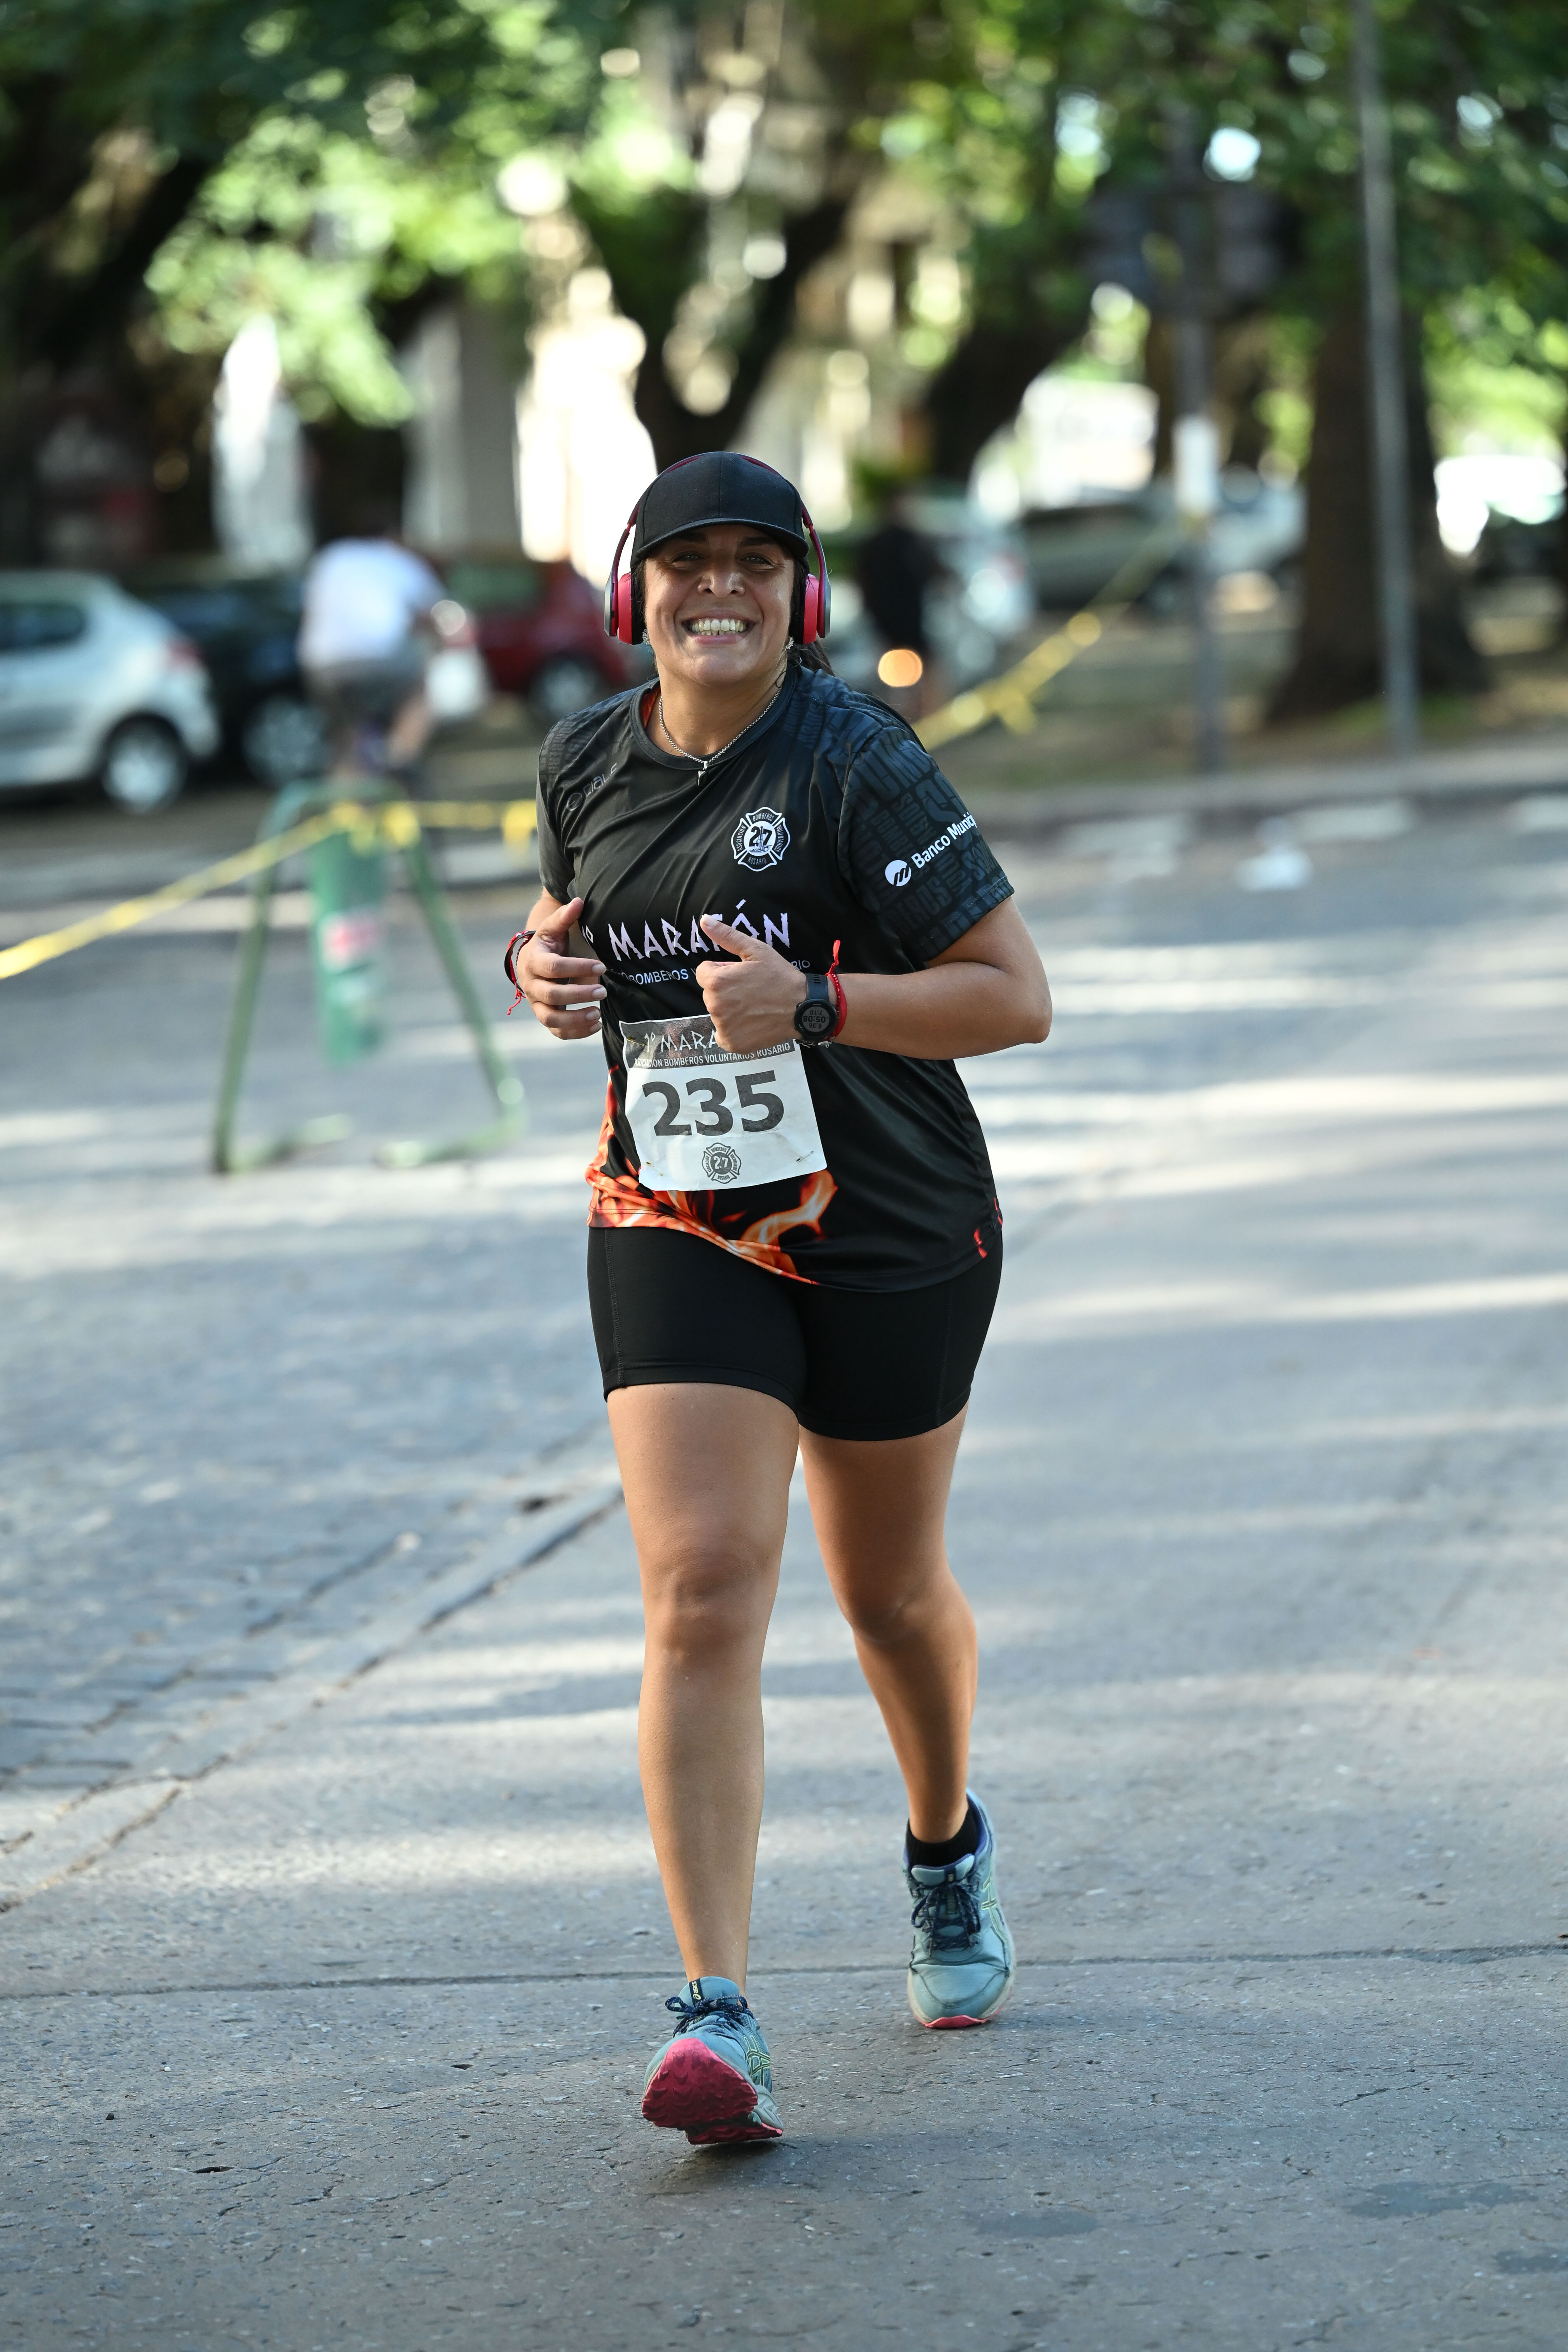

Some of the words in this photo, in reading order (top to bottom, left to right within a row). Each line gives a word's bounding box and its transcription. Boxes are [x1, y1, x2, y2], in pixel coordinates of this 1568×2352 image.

[752, 813, 774, 821] BOMBEROS
[736, 825, 746, 851] ASOCIACIÓN
[749, 826, 772, 847] 27
[774, 824, 784, 852] VOLUNTARIOS
[747, 857, 767, 865] ROSARIO
[911, 835, 951, 868] Banco
[634, 1057, 663, 1067] ASOCIACIÓN
[664, 1056, 704, 1066] BOMBEROS
[757, 1043, 790, 1057] ROSARIO
[642, 1070, 784, 1136] 235
[713, 1156, 728, 1169] 27
